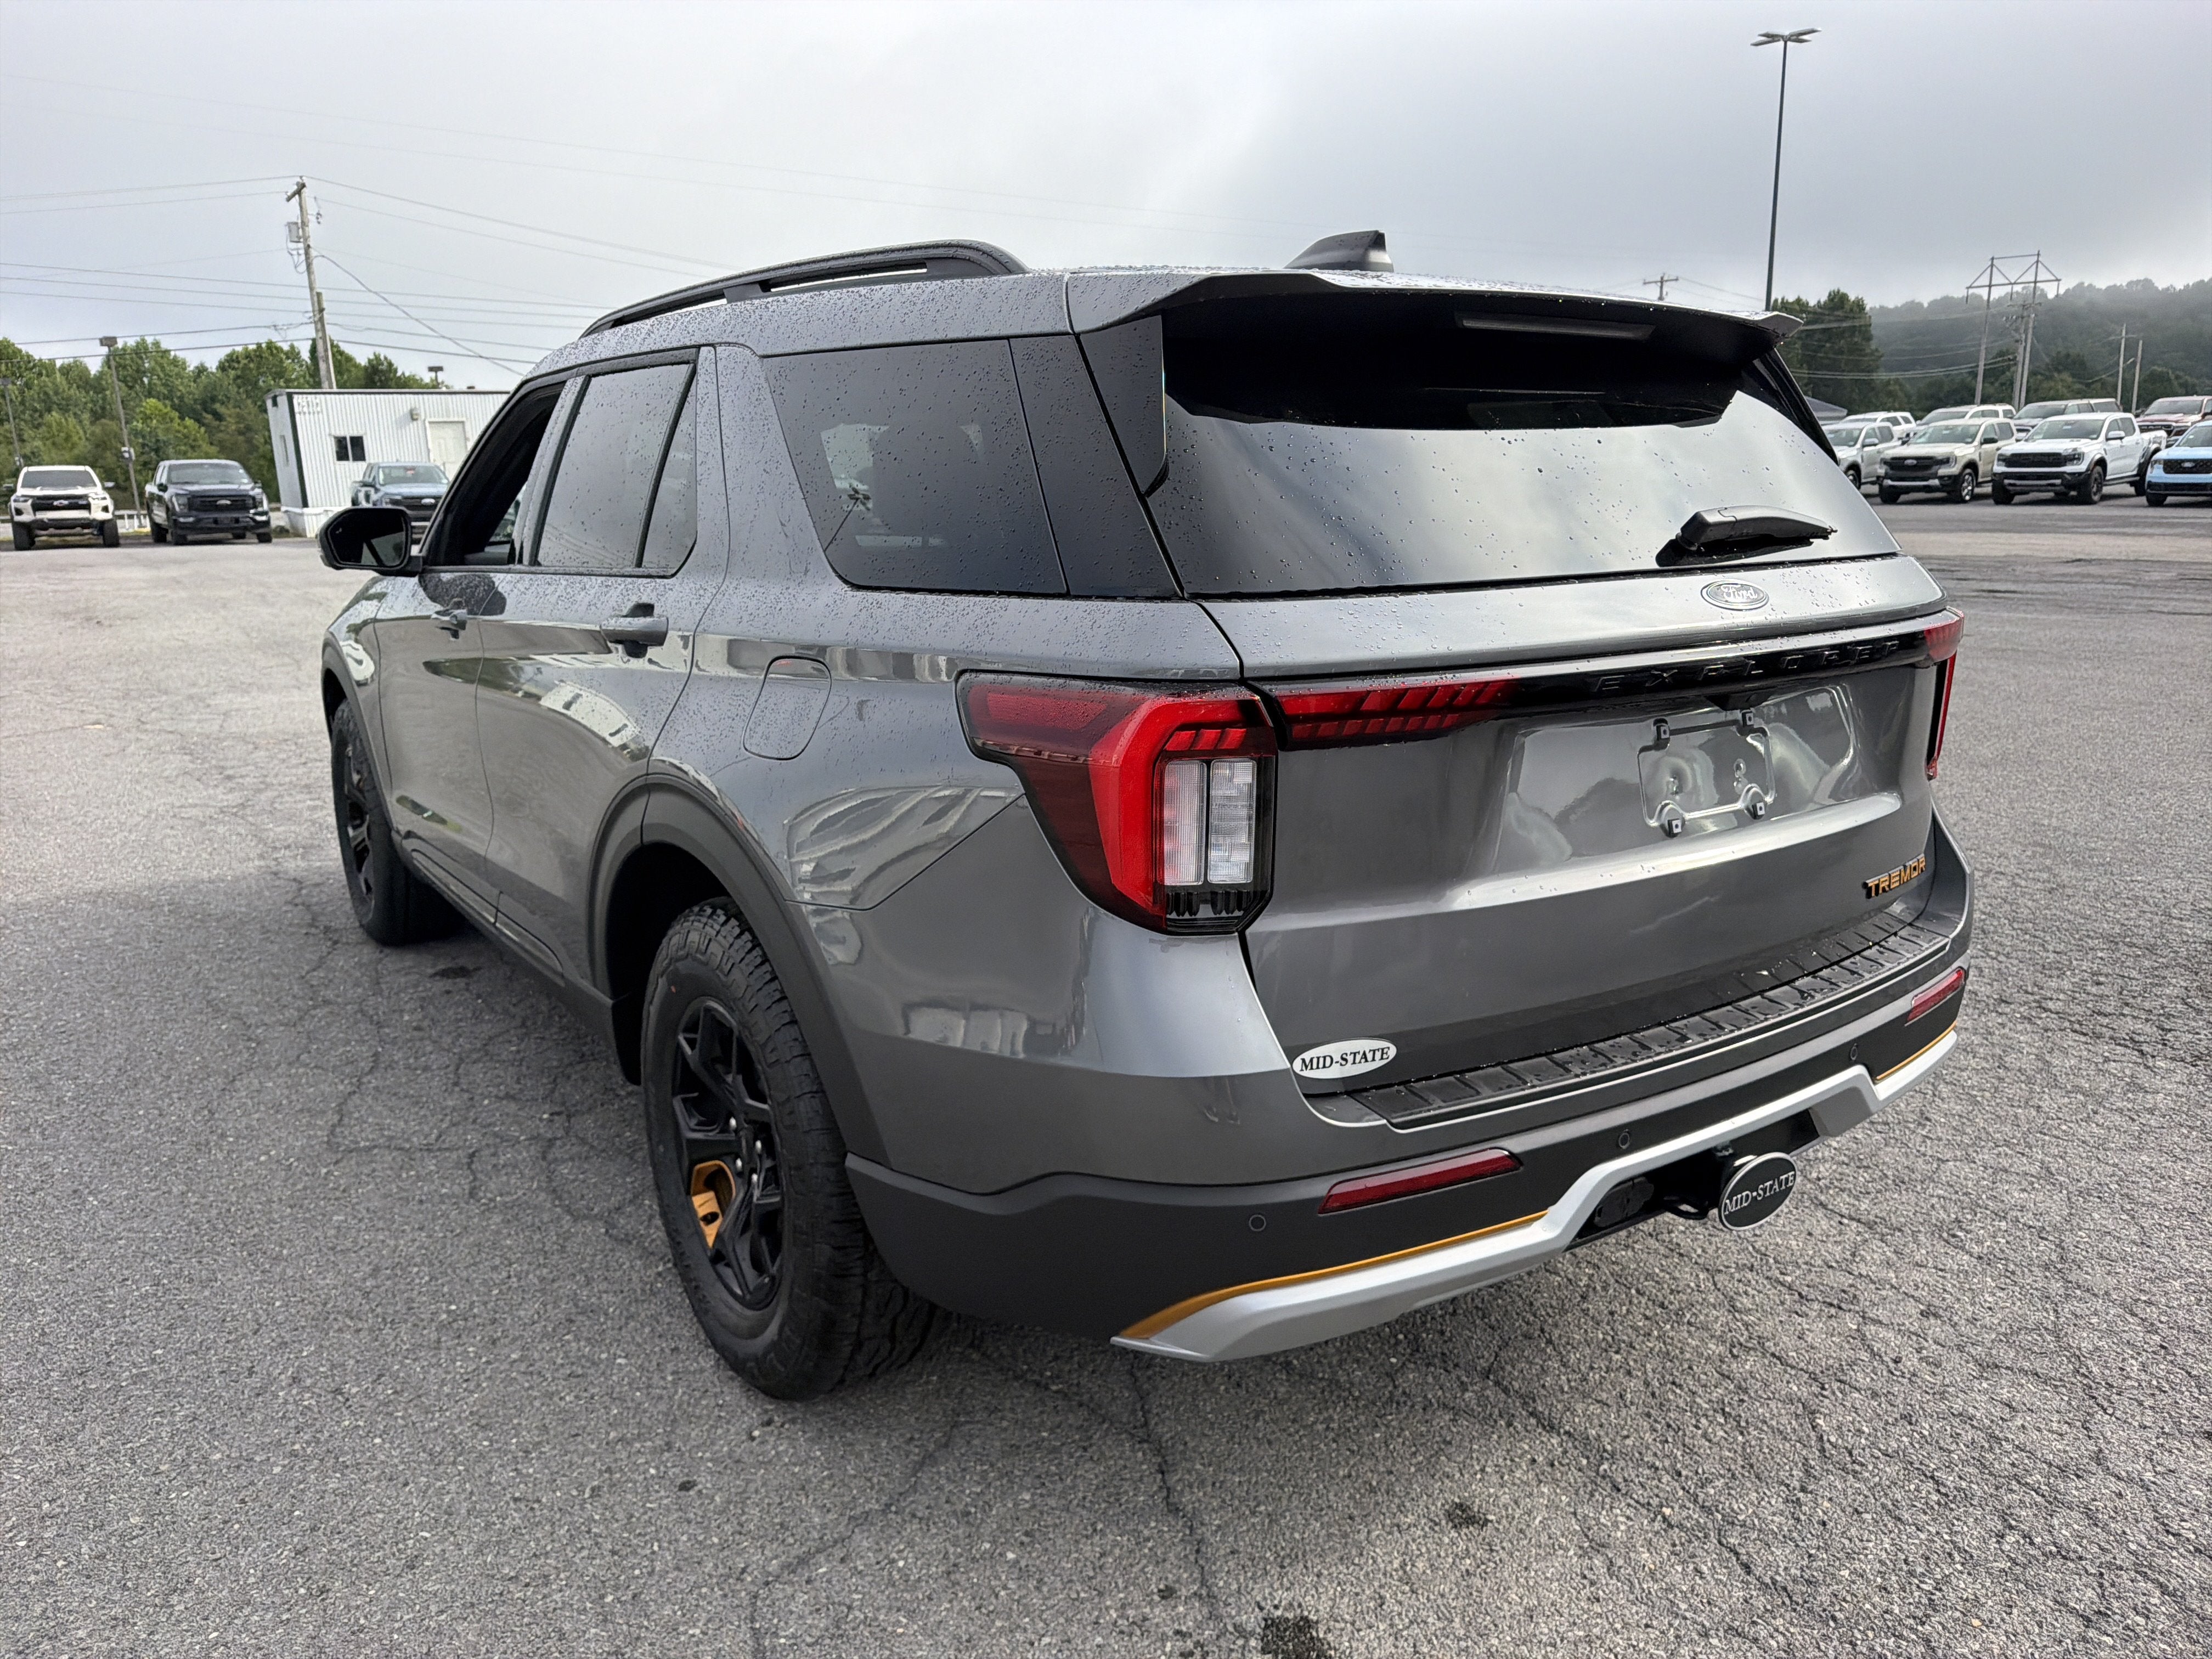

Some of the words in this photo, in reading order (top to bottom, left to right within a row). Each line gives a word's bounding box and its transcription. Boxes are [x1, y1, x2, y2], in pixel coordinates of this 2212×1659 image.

[1720, 584, 1758, 602] Ford
[1593, 641, 1899, 692] EXPLORER
[1866, 854, 1926, 897] TREMOR
[1299, 1046, 1390, 1072] MID-STATE
[1724, 1171, 1795, 1215] MID-STATE
